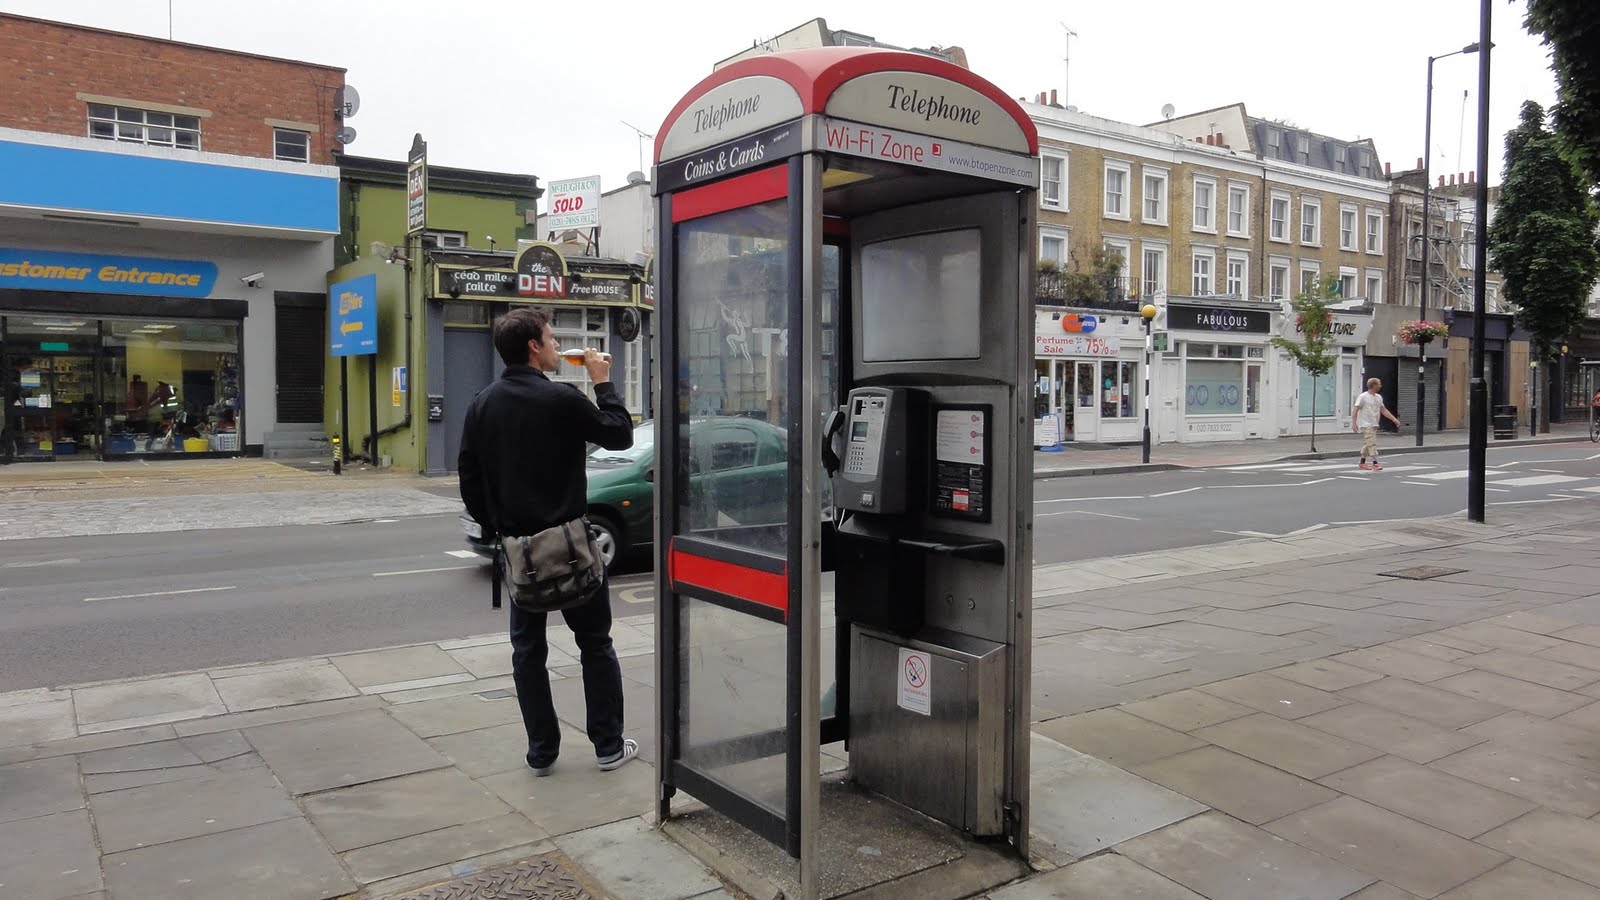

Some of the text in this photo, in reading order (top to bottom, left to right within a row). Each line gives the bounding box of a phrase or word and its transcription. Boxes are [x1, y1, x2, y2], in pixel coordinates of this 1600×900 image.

[694, 94, 760, 134] Telephone
[887, 84, 981, 126] Telephone
[826, 122, 924, 163] Wi-Fi Zone
[684, 140, 765, 181] Coins & Cards
[948, 155, 1033, 179] www.btopenzone.com
[553, 196, 583, 214] SOLD
[0, 261, 202, 287] stomer Entrance
[531, 262, 549, 274] the
[518, 274, 564, 294] DEN
[570, 283, 619, 295] Free HOUSE
[644, 284, 654, 299] DE
[1197, 313, 1248, 327] FABULOUS
[1036, 335, 1074, 345] Perfume
[1085, 338, 1109, 355] 75%
[1043, 345, 1064, 354] Sale
